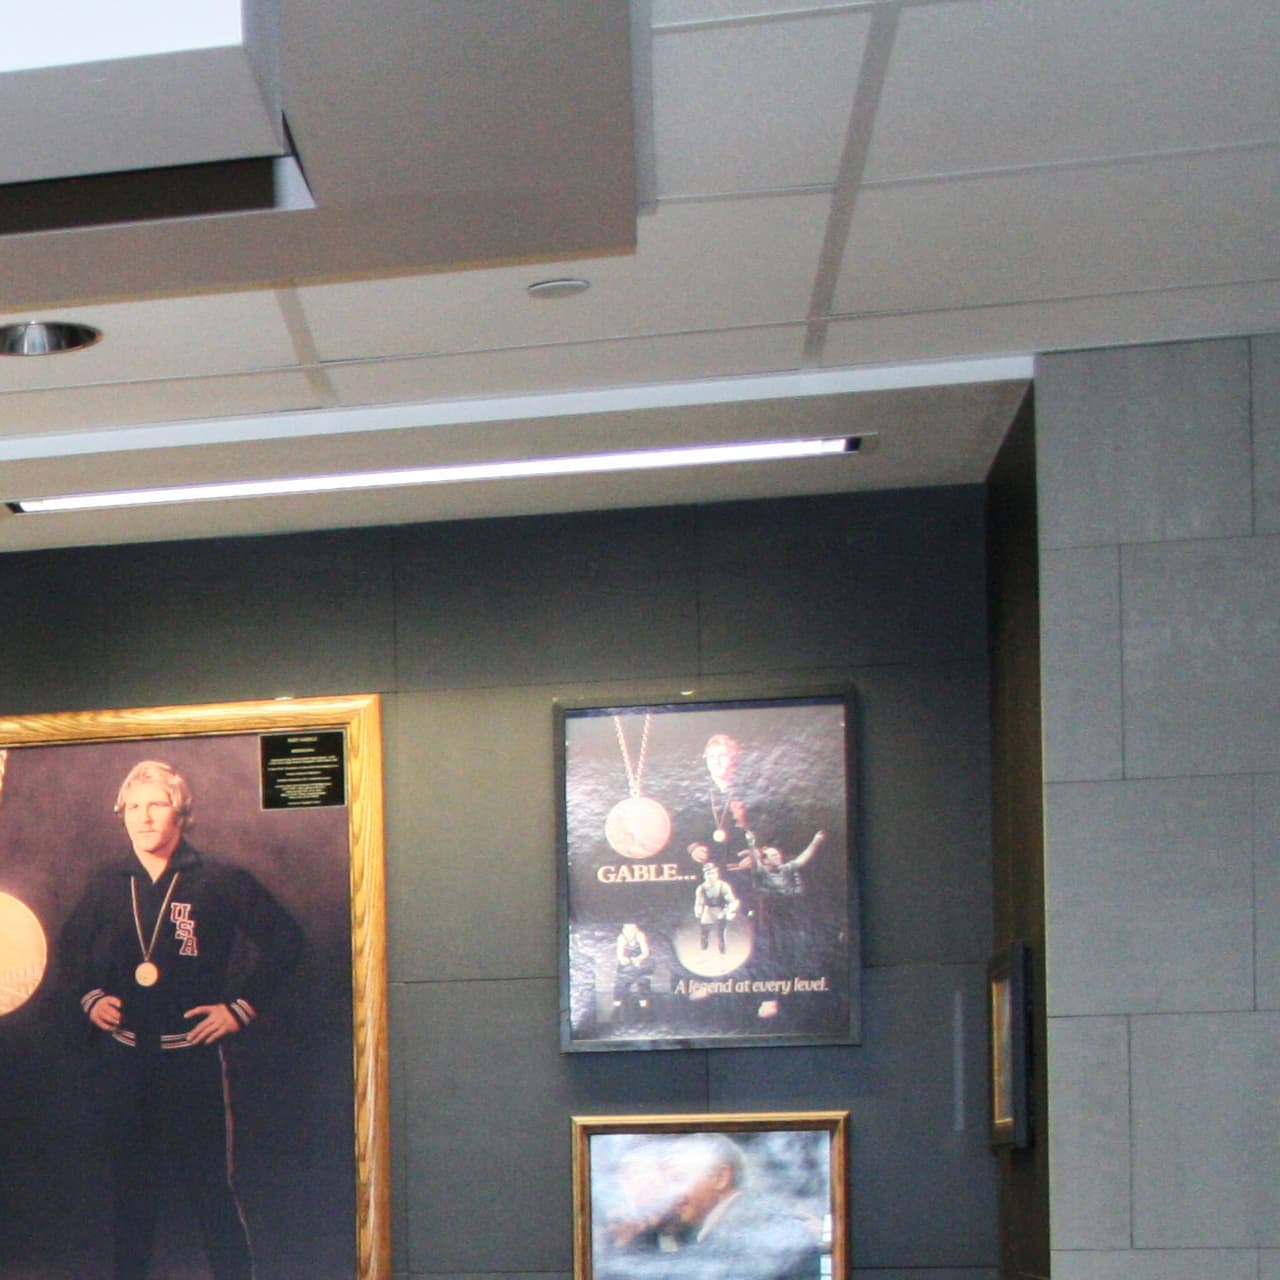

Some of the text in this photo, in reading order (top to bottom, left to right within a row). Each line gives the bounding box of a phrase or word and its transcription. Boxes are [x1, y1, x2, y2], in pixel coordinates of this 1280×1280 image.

[170, 902, 198, 956] USA
[674, 979, 686, 994] A
[689, 978, 733, 996] legend
[735, 980, 750, 994] at
[752, 979, 791, 995] every
